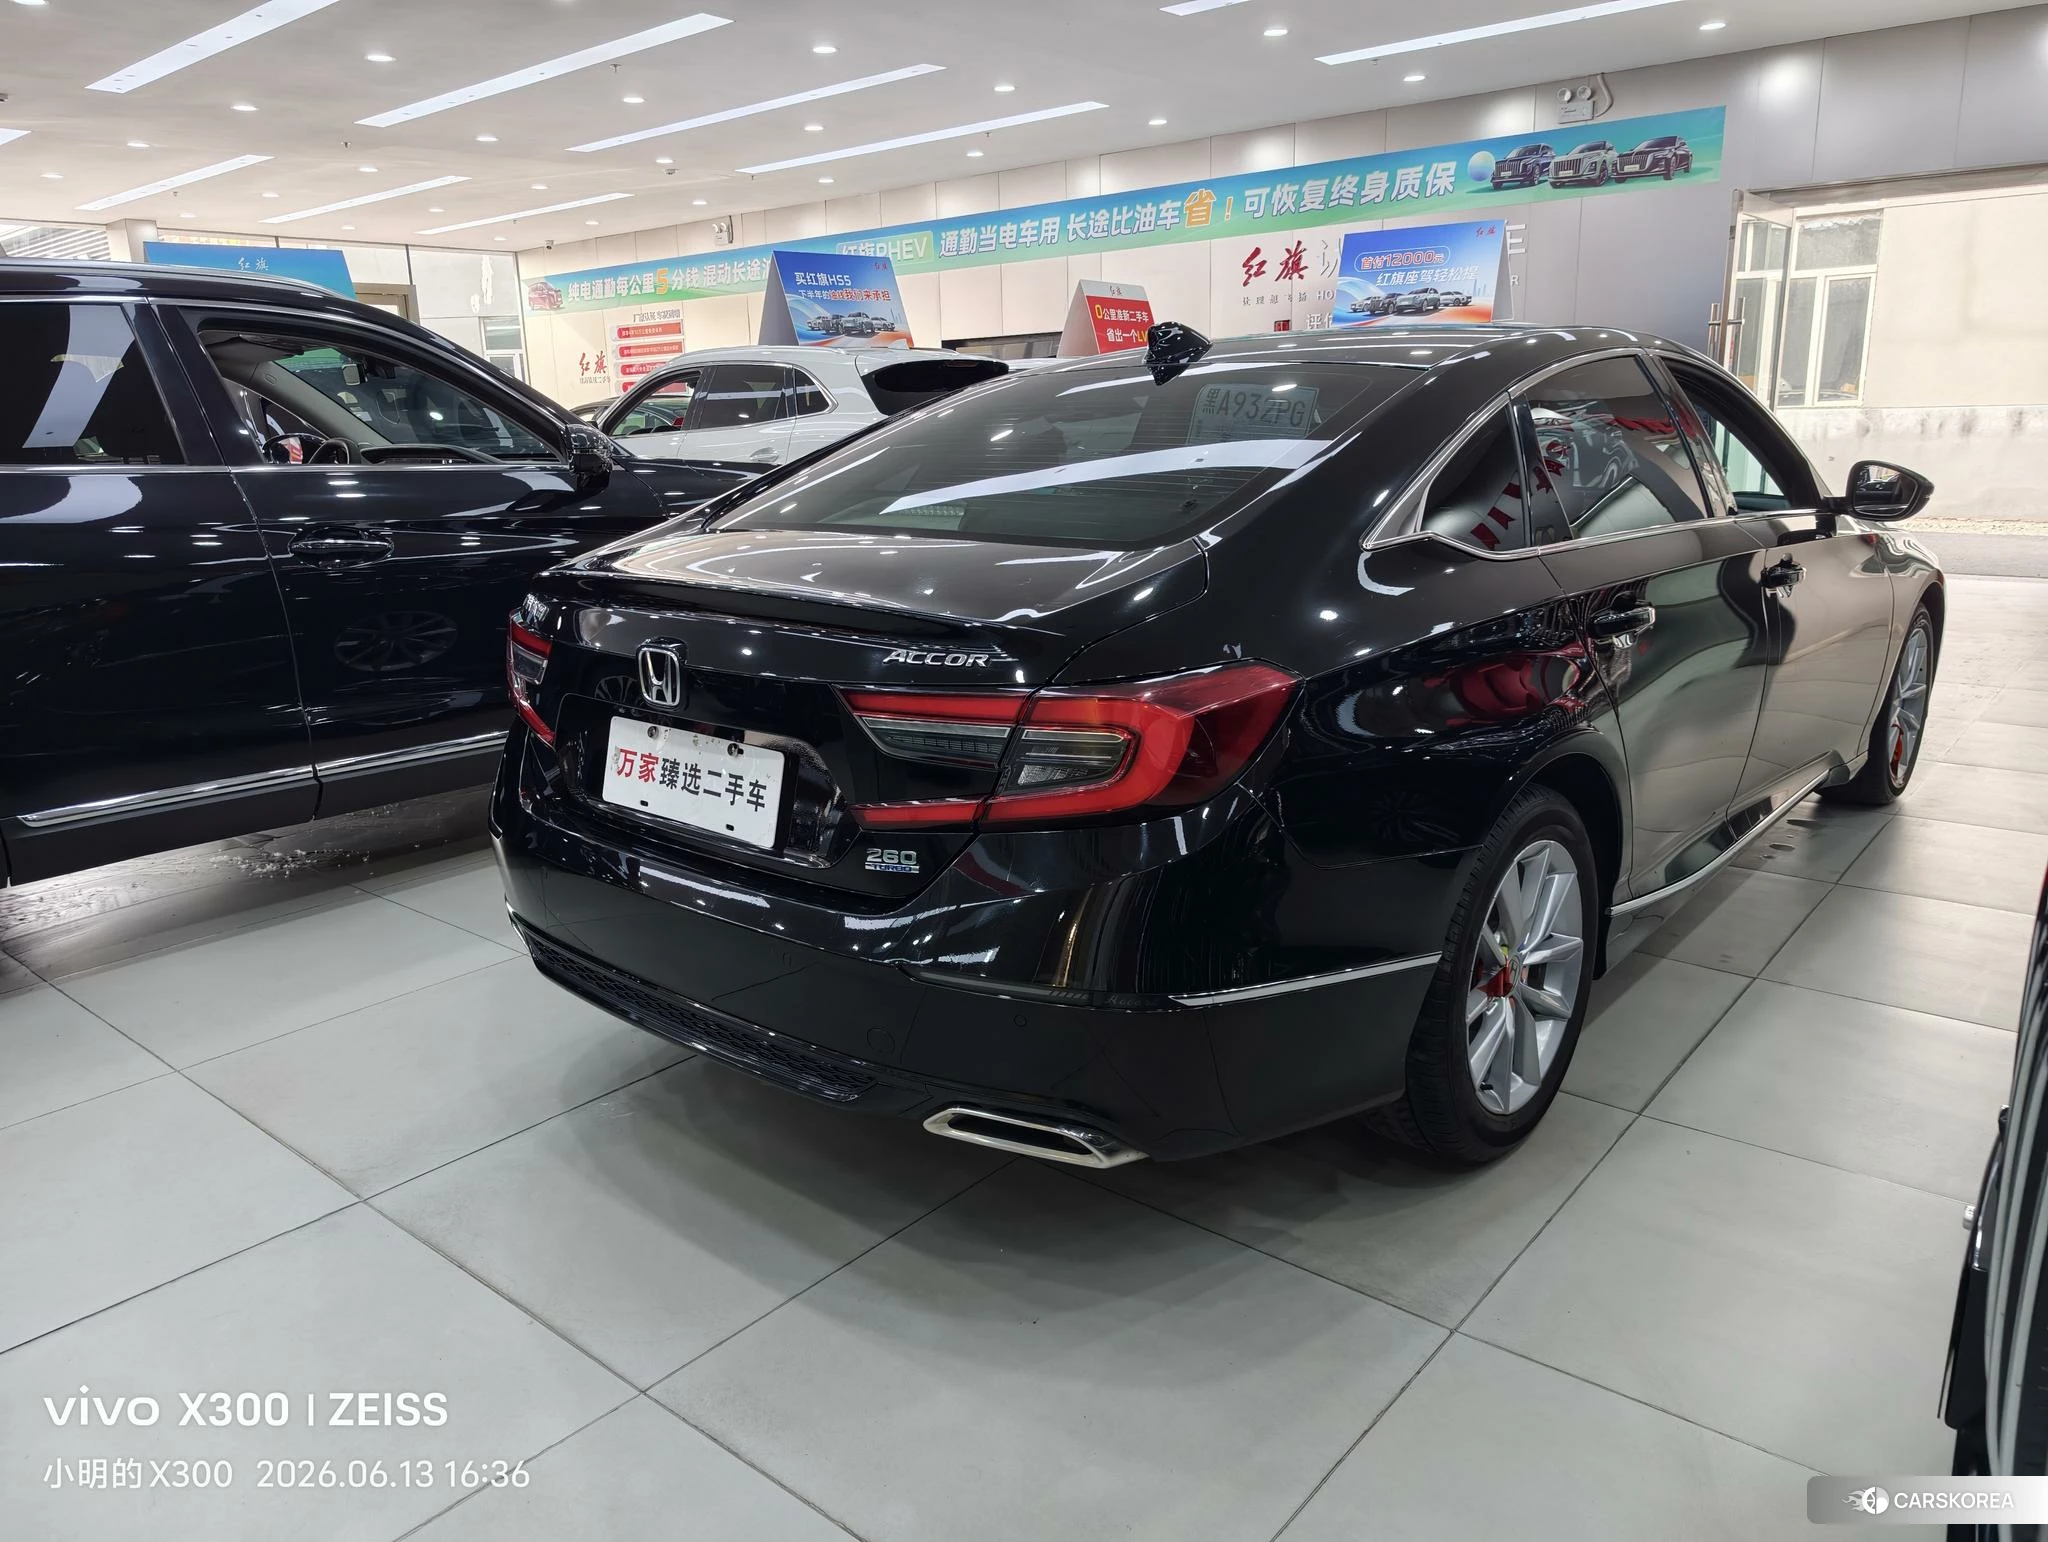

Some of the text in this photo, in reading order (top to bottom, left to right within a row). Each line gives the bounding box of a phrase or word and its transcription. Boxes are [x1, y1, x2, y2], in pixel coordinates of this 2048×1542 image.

[939, 216, 1061, 259] 通勤当电车用
[1243, 160, 1458, 219] 可恢复终身质保
[1361, 250, 1446, 270] 首付12000元
[794, 271, 852, 286] 买红旗HS5
[616, 748, 767, 812] 万家臻选二手车
[866, 847, 917, 865] 260
